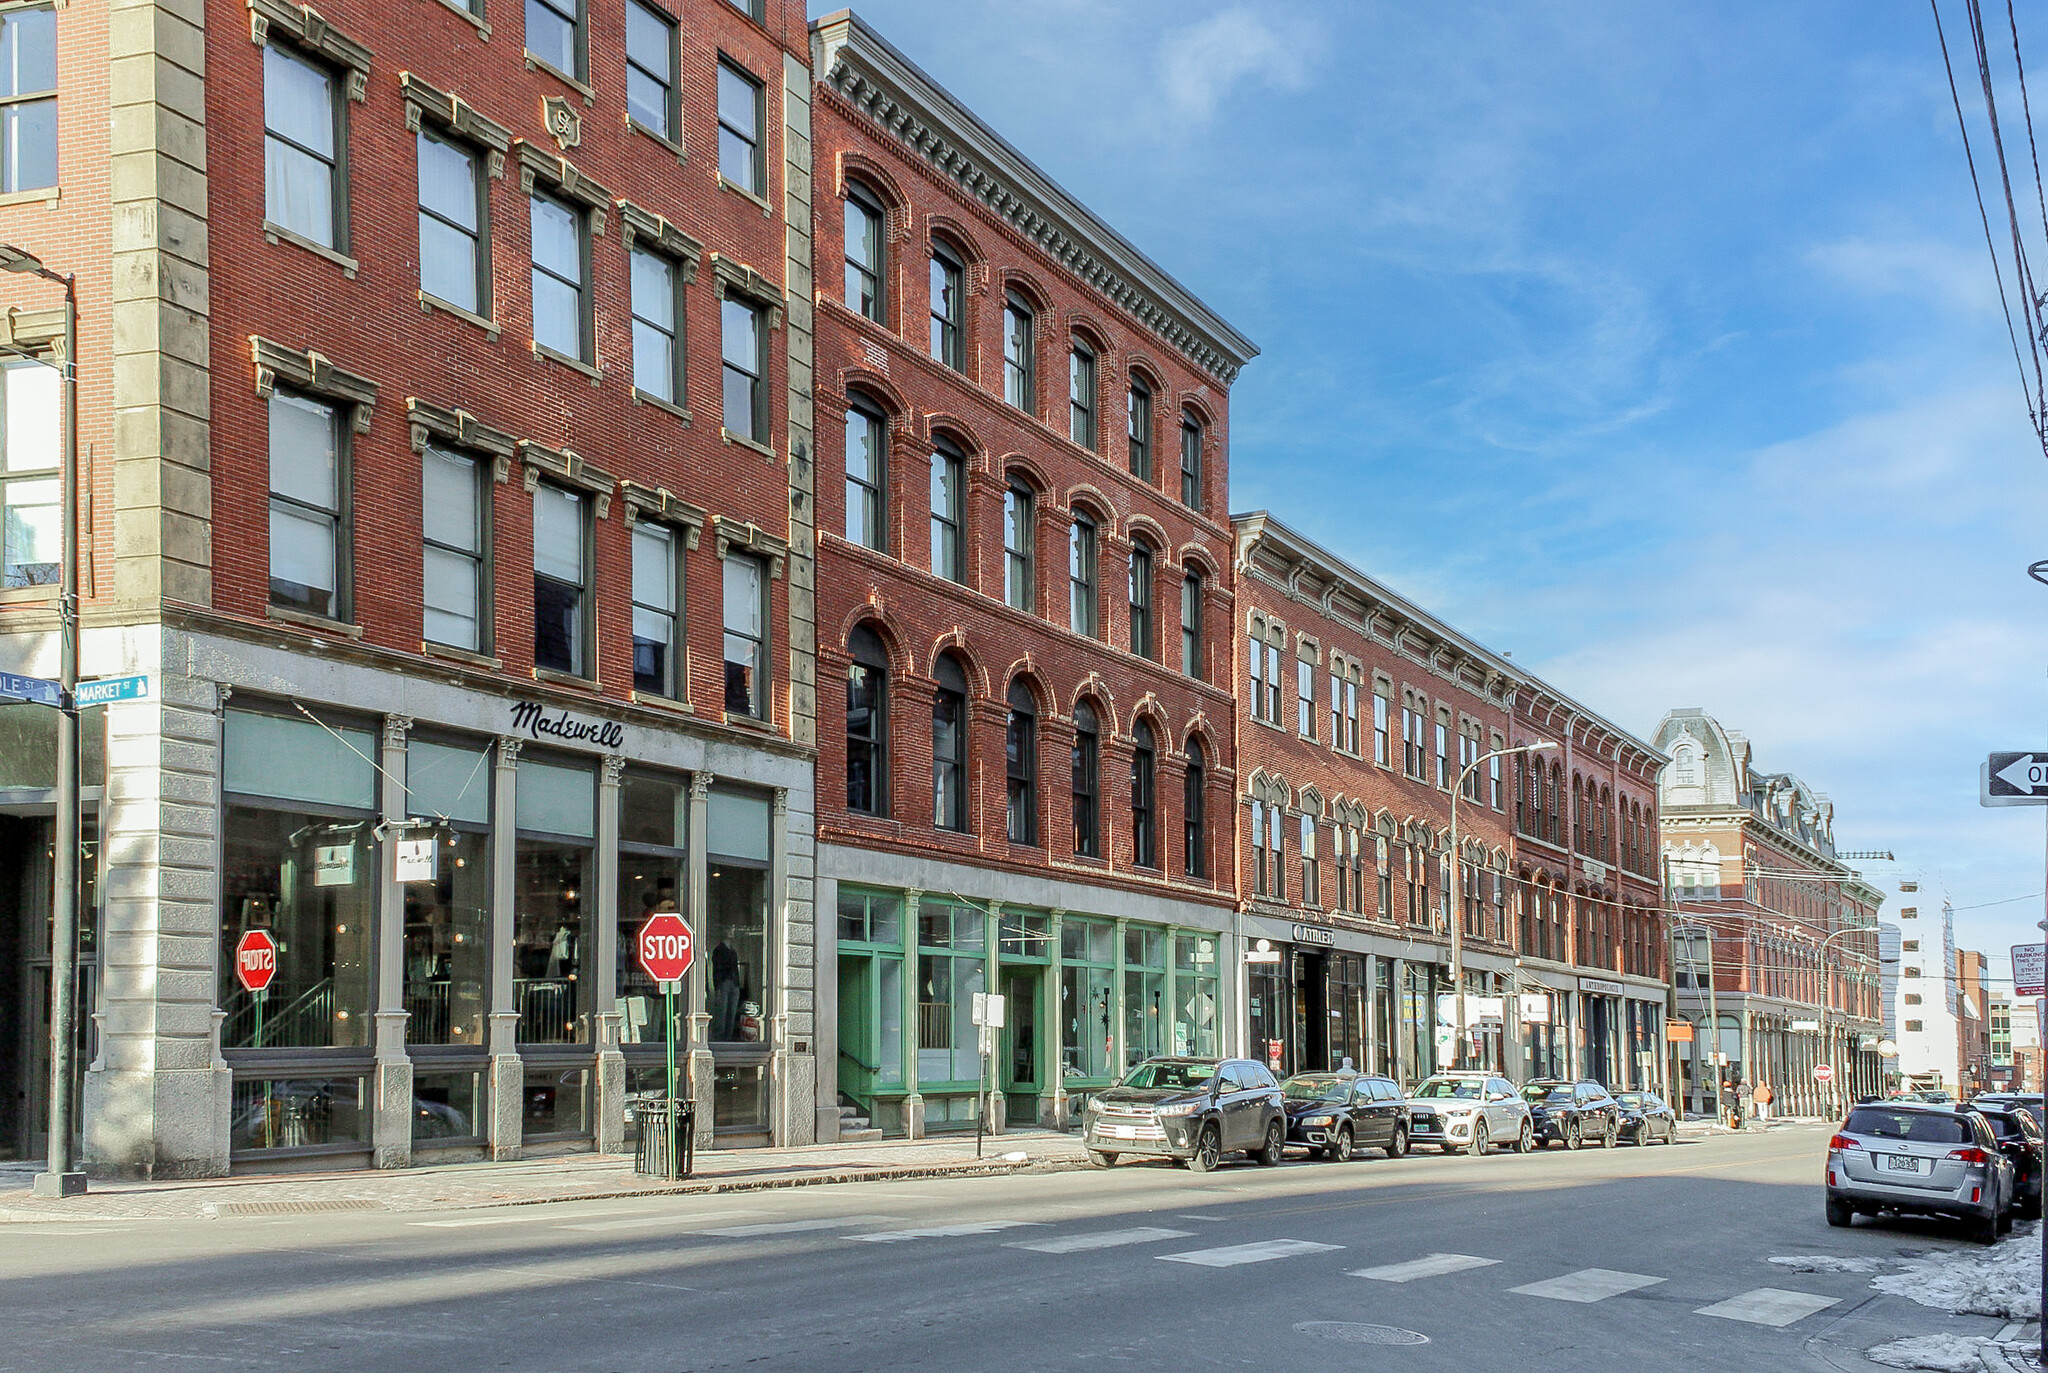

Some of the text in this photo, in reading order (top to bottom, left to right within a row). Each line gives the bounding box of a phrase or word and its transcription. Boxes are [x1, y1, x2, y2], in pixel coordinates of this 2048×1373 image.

[25, 680, 35, 690] ST
[80, 680, 131, 702] MARKET ST
[510, 701, 624, 748] Madewell
[644, 934, 690, 960] STOP
